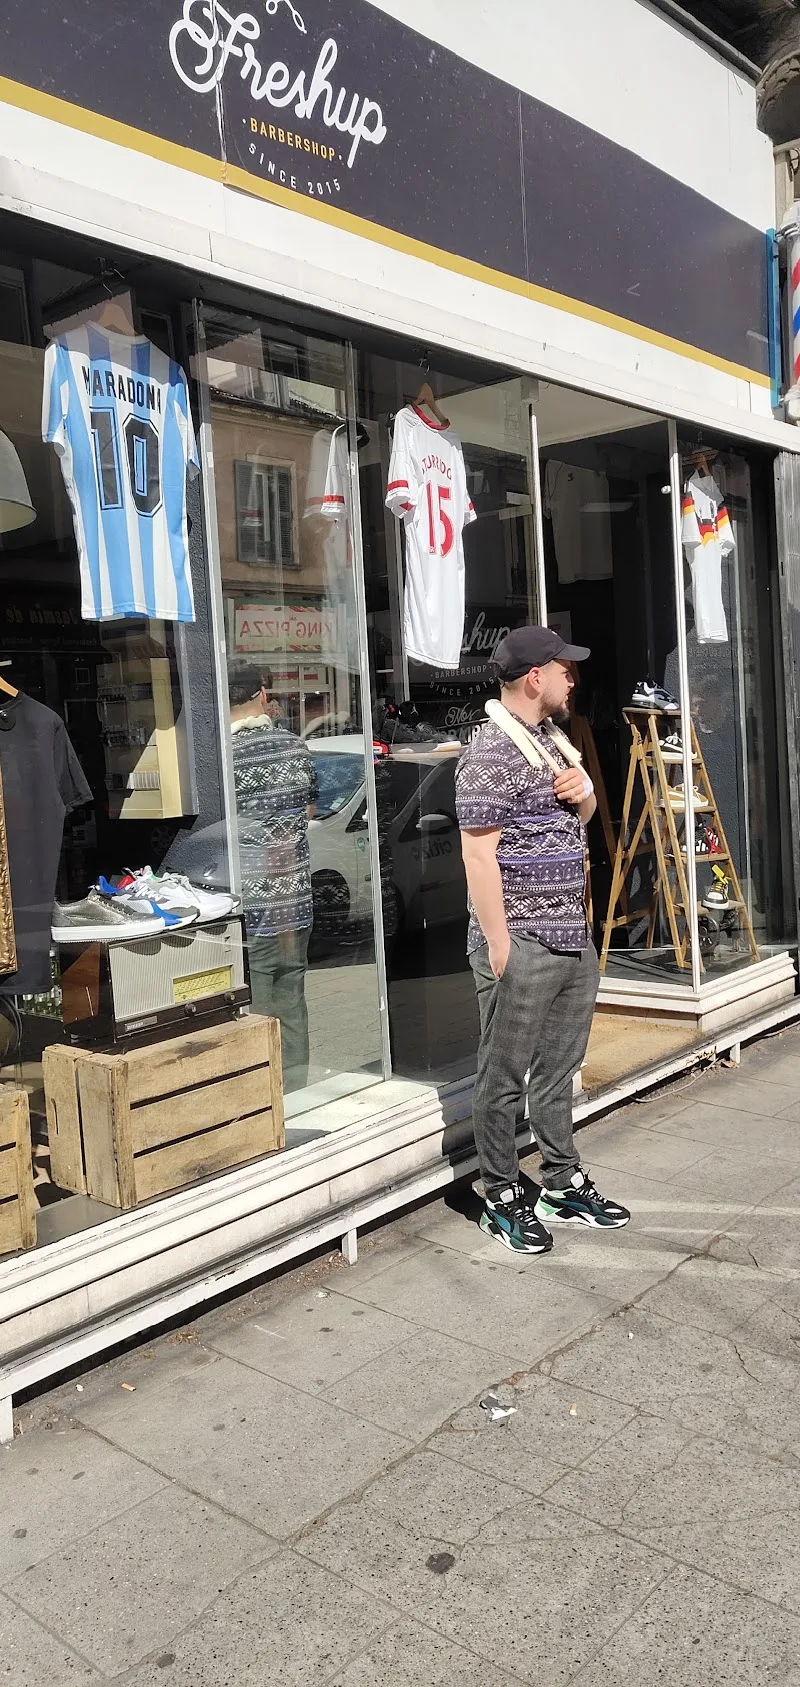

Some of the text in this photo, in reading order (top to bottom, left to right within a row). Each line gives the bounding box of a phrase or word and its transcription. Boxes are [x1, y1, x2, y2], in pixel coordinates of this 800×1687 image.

[169, 0, 387, 168] Freshup
[250, 117, 336, 162] BARBERSHOP
[248, 142, 342, 195] SINCE 2015
[89, 406, 163, 518] 10
[425, 480, 455, 558] 15
[429, 677, 496, 696] SINCE 2015
[435, 665, 488, 679] BARBERSHOP
